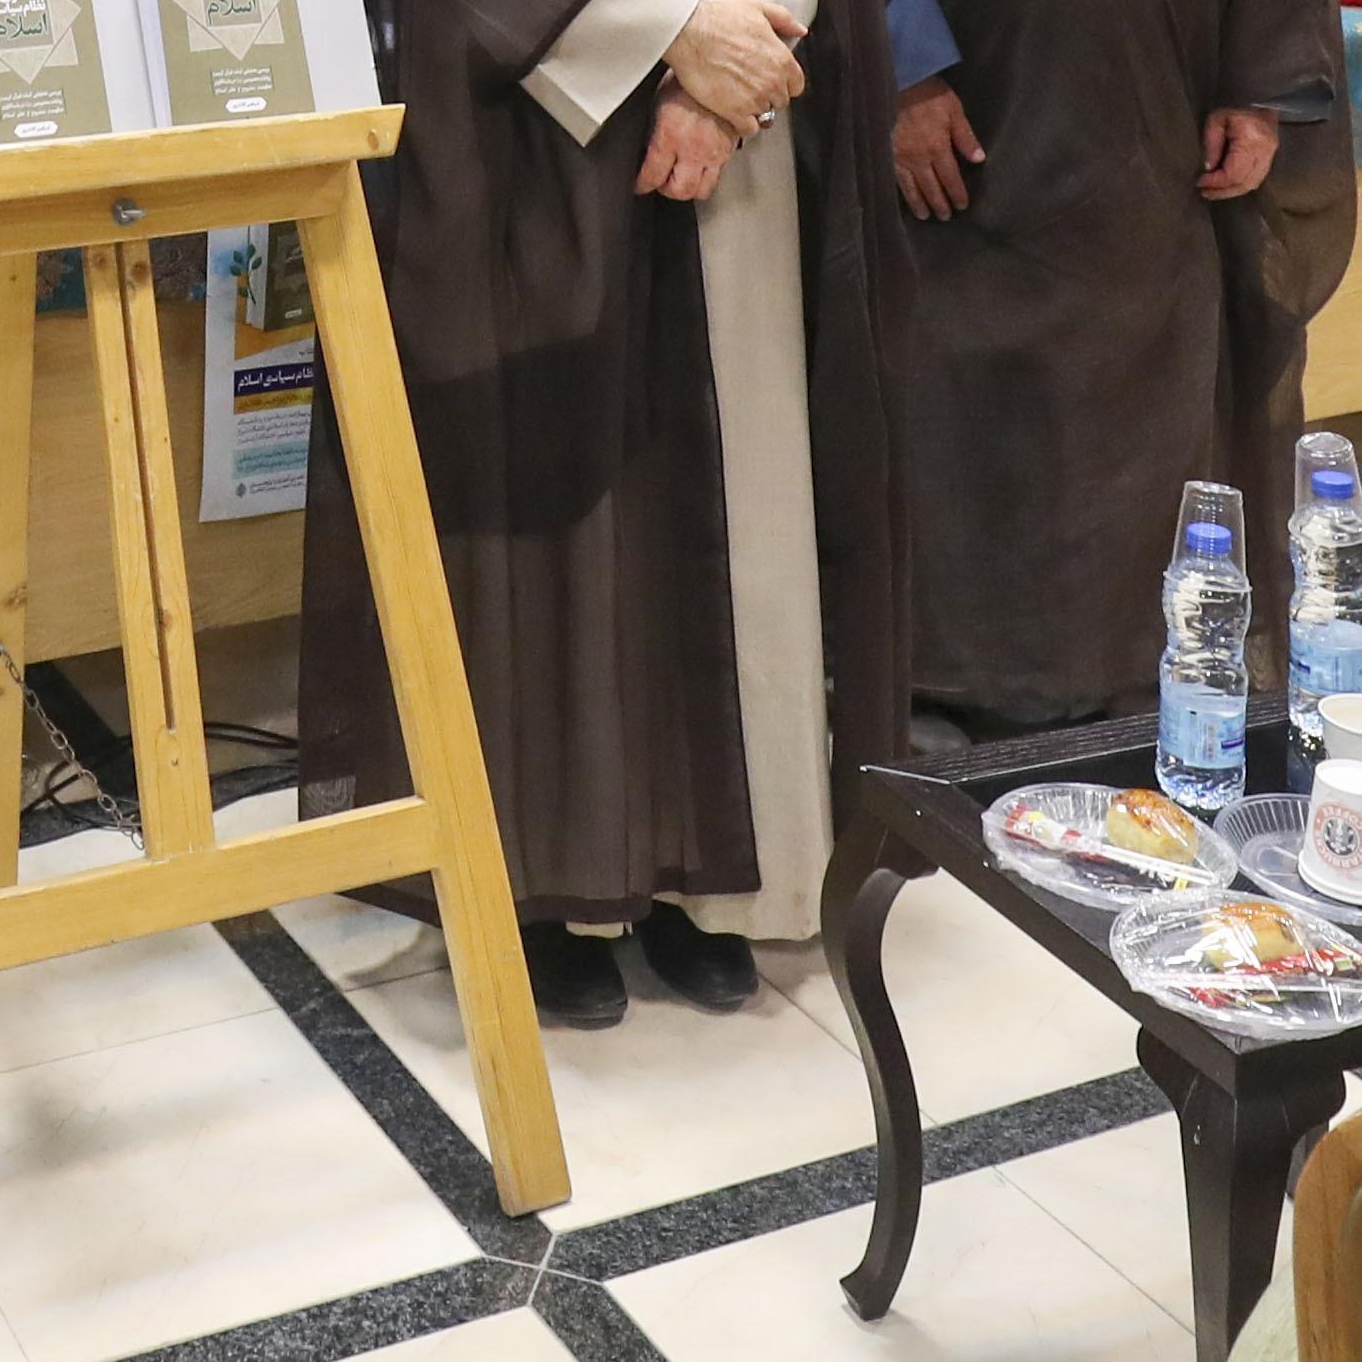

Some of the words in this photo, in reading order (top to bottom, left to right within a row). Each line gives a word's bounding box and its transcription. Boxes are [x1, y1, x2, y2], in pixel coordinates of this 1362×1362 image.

[237, 372, 263, 393] اسلام
[262, 369, 296, 387] سیاسی
[295, 366, 314, 386] ظام
